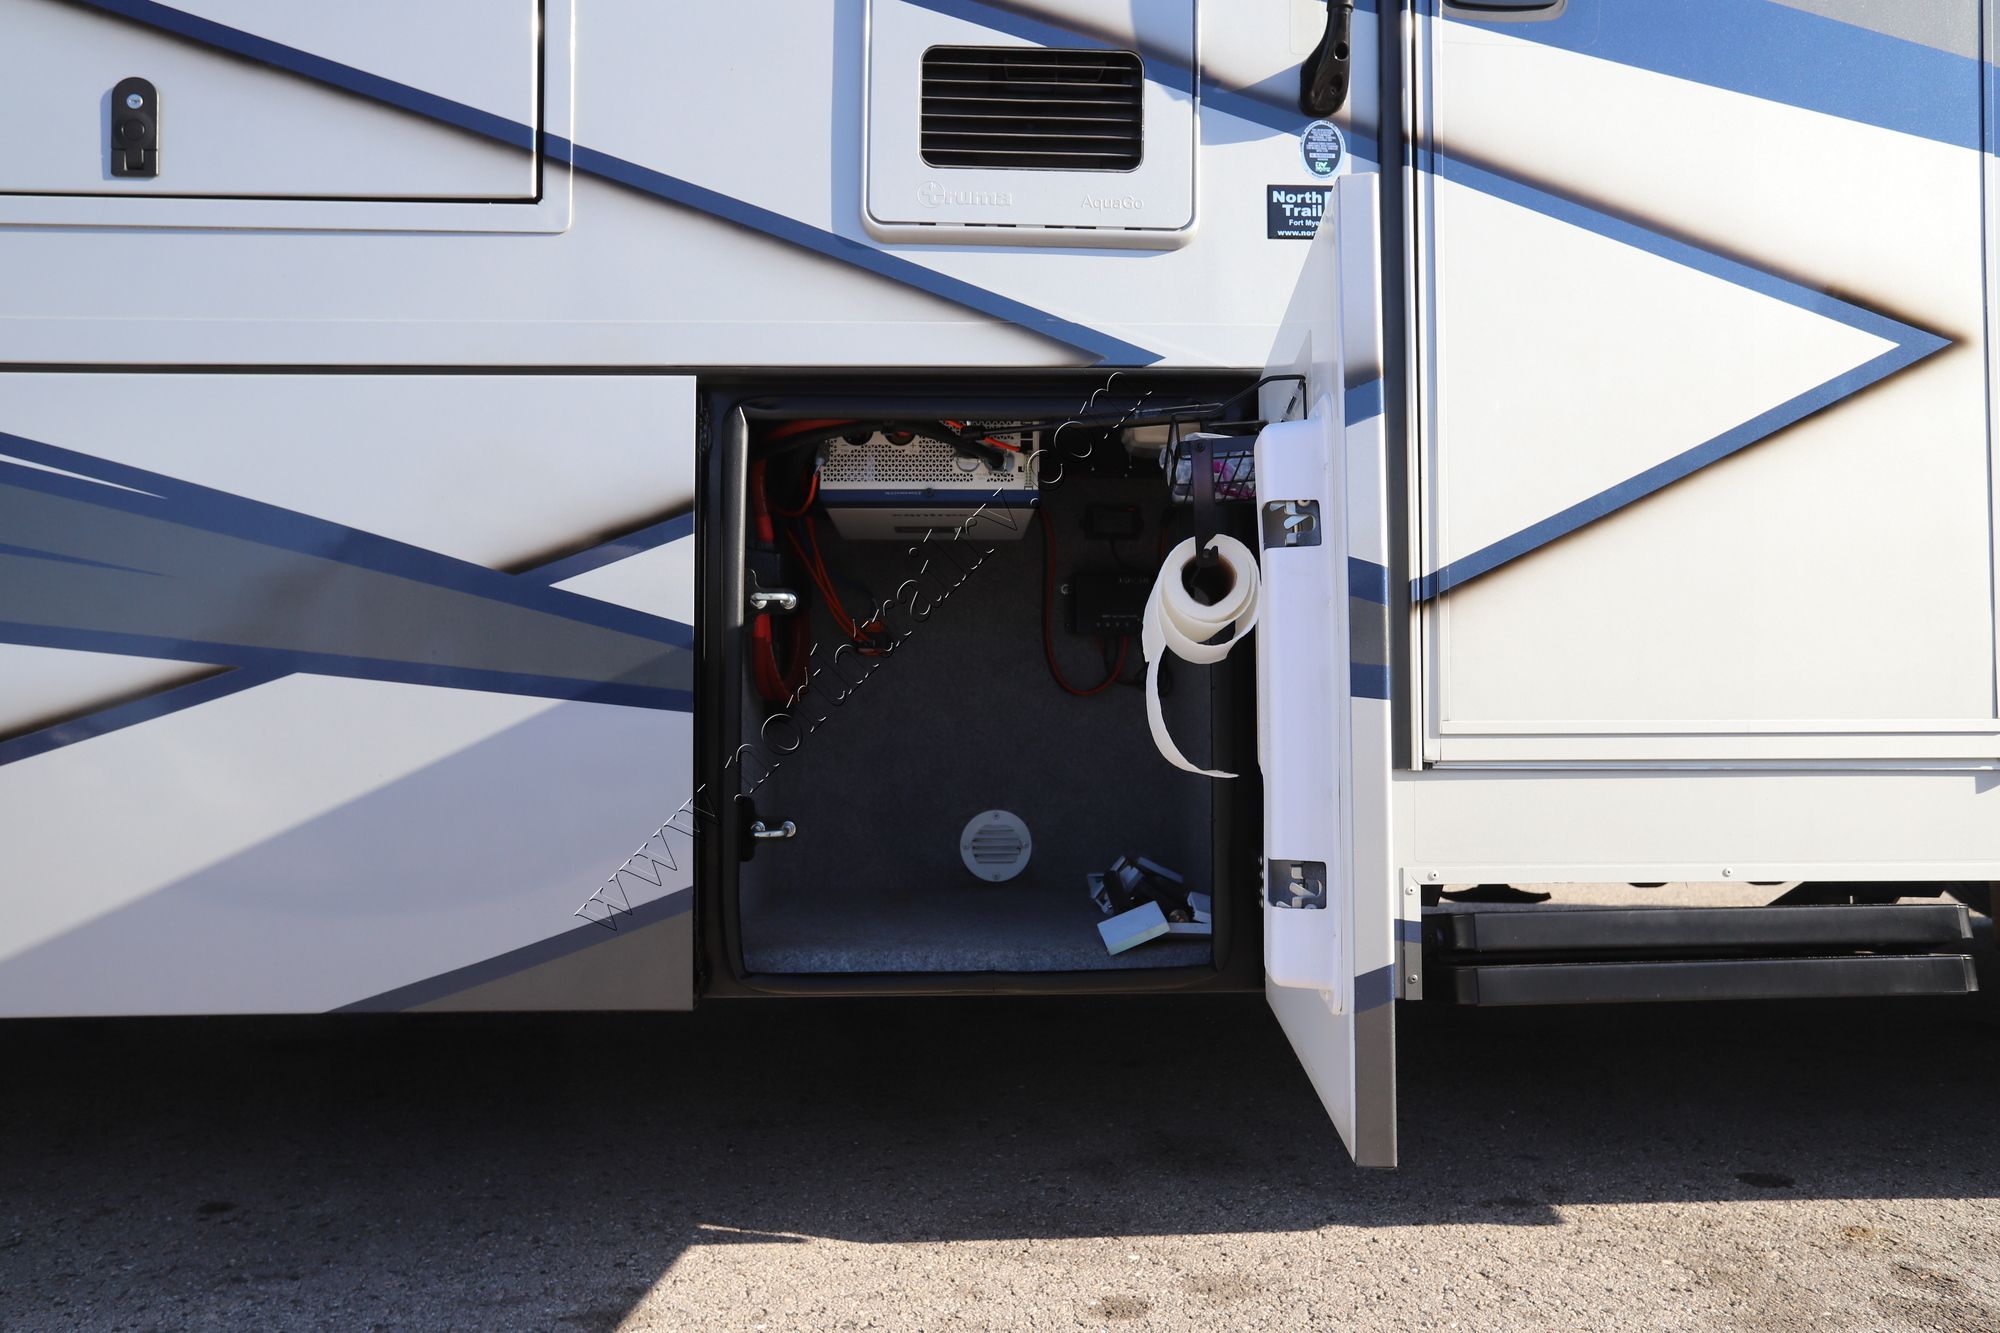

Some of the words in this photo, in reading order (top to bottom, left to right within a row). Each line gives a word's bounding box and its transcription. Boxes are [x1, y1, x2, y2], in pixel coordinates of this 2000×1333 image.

[1080, 193, 1145, 212] AquaGo
[1272, 190, 1322, 204] North
[1282, 204, 1322, 217] Trail
